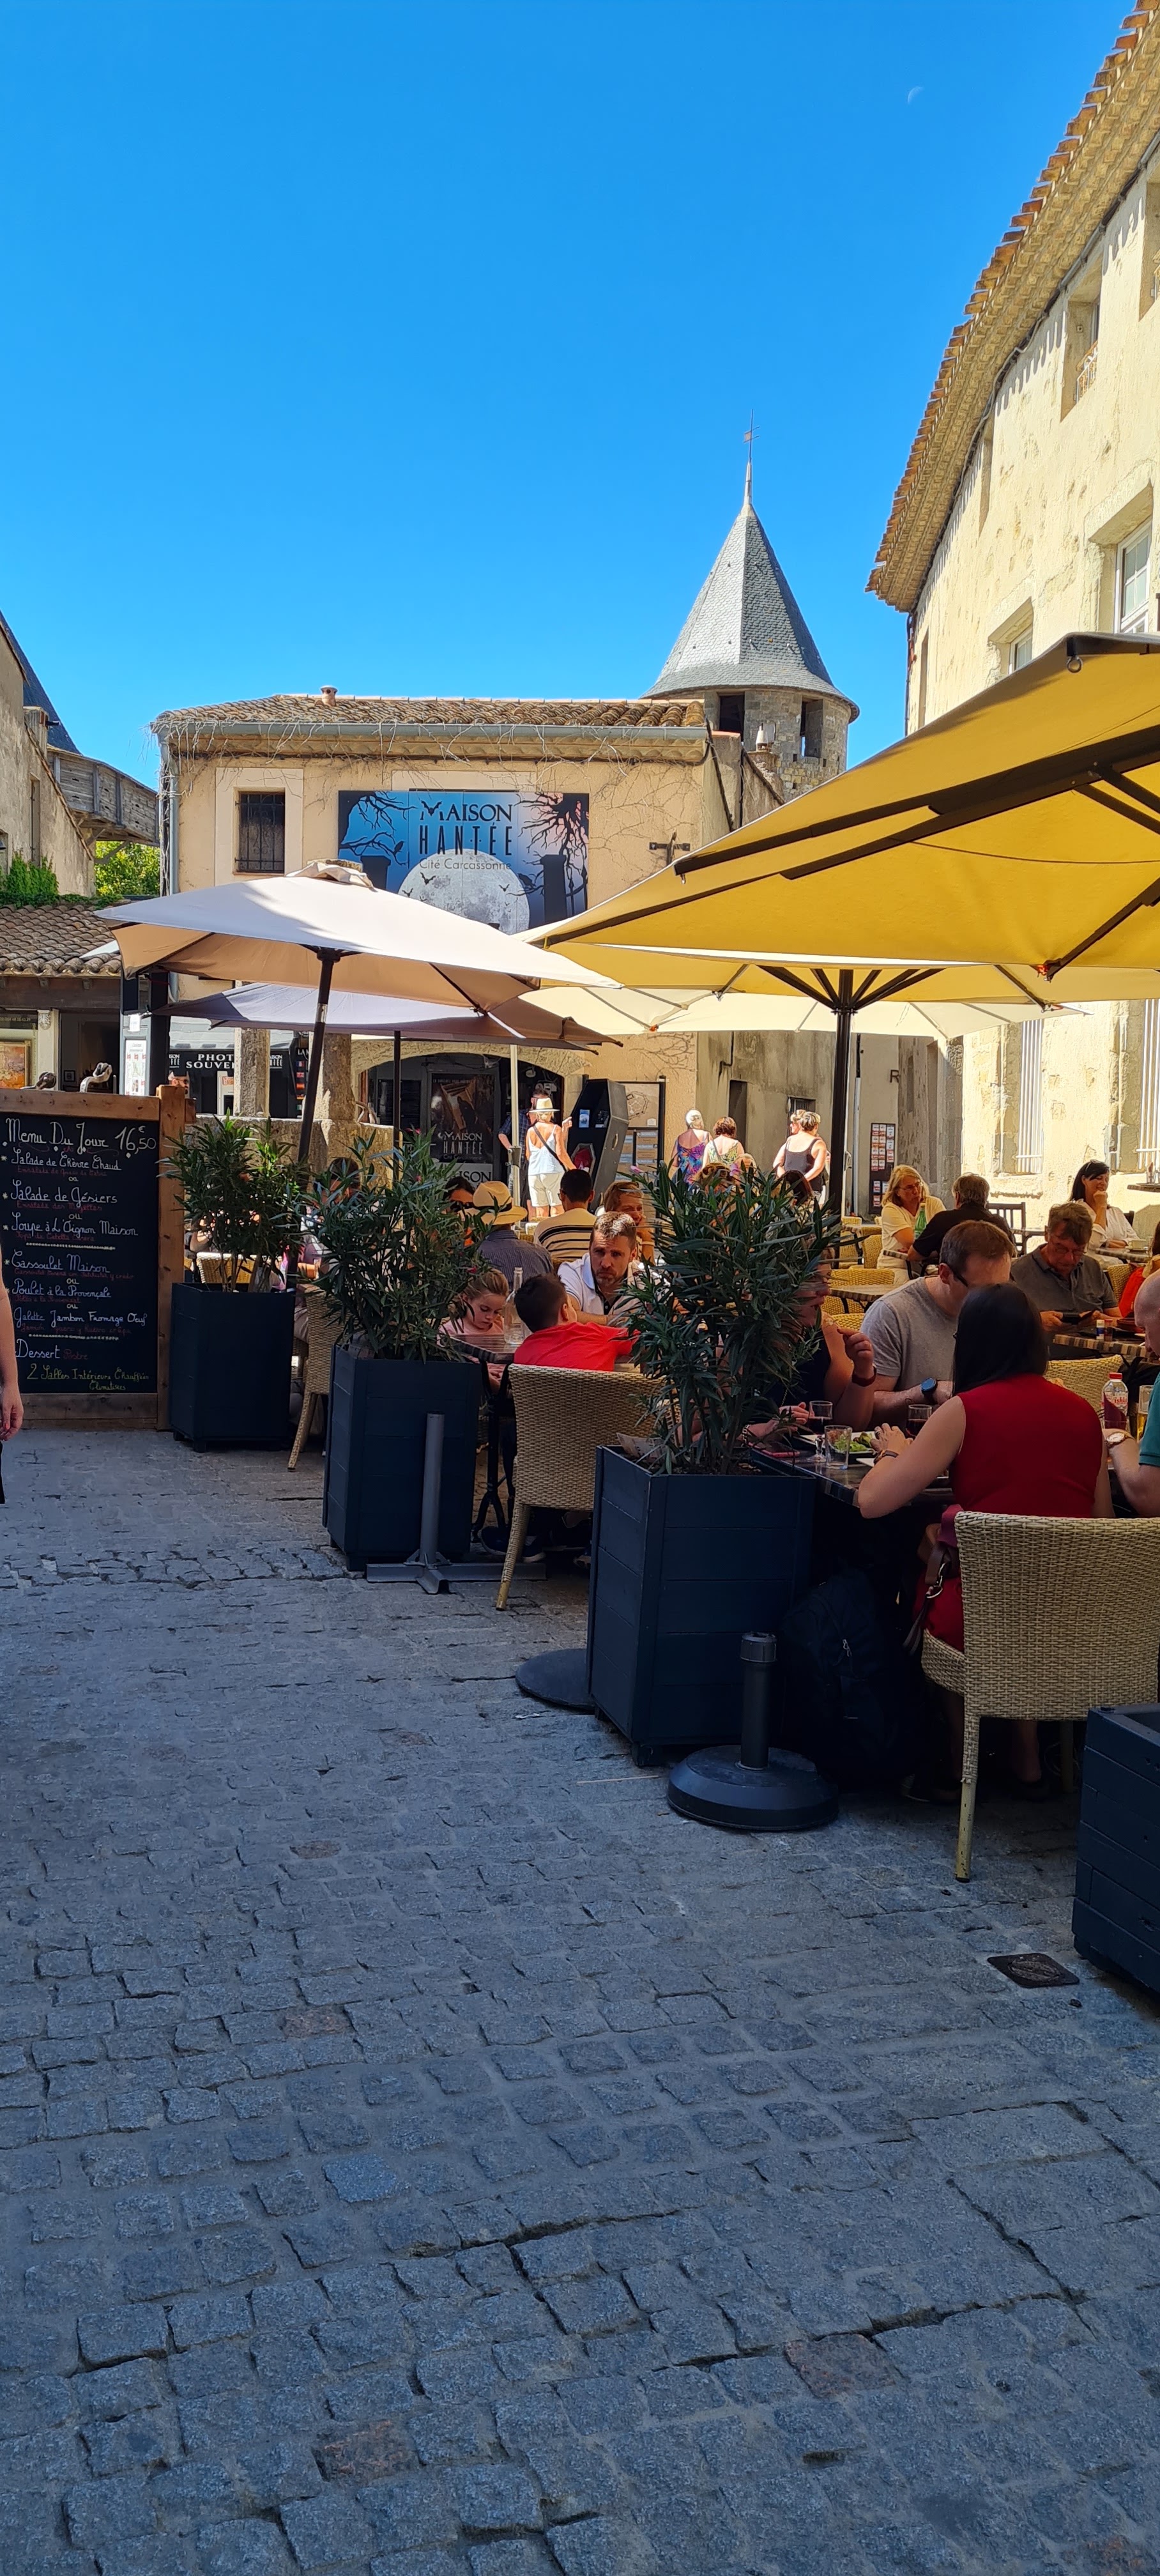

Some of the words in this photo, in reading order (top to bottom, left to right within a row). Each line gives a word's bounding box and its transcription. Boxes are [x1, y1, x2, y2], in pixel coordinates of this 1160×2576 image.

[420, 800, 513, 822] MAISON
[419, 822, 512, 855] HANTÉE
[419, 858, 440, 870] Cité
[445, 858, 512, 870] Carcassonne
[6, 1118, 47, 1144] Menu
[49, 1122, 74, 1146] Du
[76, 1122, 109, 1154] Jour
[444, 1131, 482, 1140] MAISON
[443, 1140, 482, 1154] HANTÉE
[11, 1147, 44, 1166] Salade
[46, 1156, 57, 1167] de
[59, 1151, 89, 1169] Chèvre
[92, 1155, 122, 1170] Chaud
[459, 1170, 491, 1182] ISON
[11, 1179, 50, 1201] Salade
[54, 1187, 68, 1202] de
[71, 1187, 118, 1208] Gésiers
[11, 1212, 43, 1237] Soupe
[99, 1220, 139, 1236] Maison
[11, 1249, 63, 1270] Cassoulet
[66, 1254, 110, 1273] Maison
[12, 1278, 44, 1296] Poulet
[55, 1282, 66, 1296] la
[68, 1285, 111, 1300] Provençale
[14, 1307, 45, 1328] Galette
[50, 1310, 85, 1328] Jambon
[88, 1311, 124, 1327] Fromage
[15, 1339, 60, 1359] Dessert
[27, 1363, 39, 1379] 2
[40, 1364, 70, 1379] Salles
[72, 1368, 111, 1380] Intérieurs
